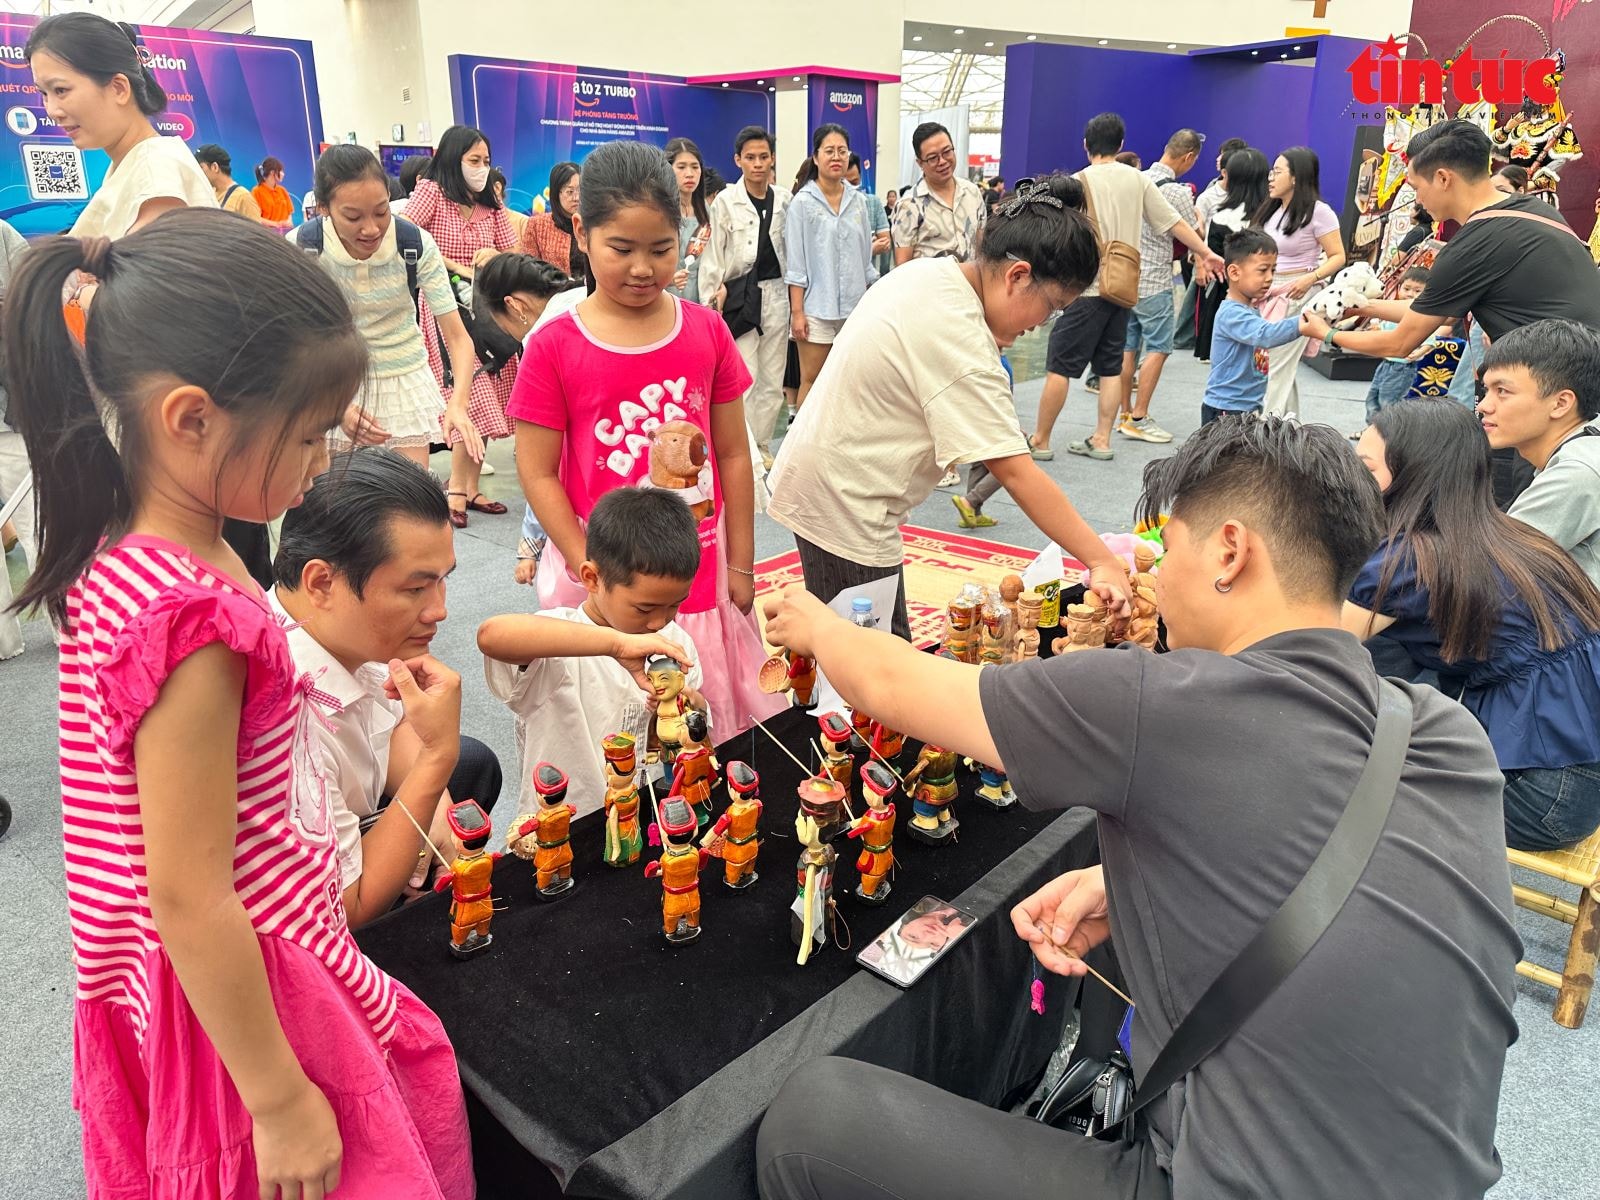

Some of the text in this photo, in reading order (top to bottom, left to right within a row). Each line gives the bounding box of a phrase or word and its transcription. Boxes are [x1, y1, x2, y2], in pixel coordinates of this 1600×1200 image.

[22, 85, 37, 94] QR
[573, 80, 637, 98] a to z TURBO
[830, 91, 863, 105] amazon
[157, 122, 185, 132] VIDEO
[594, 376, 687, 446] CAPY
